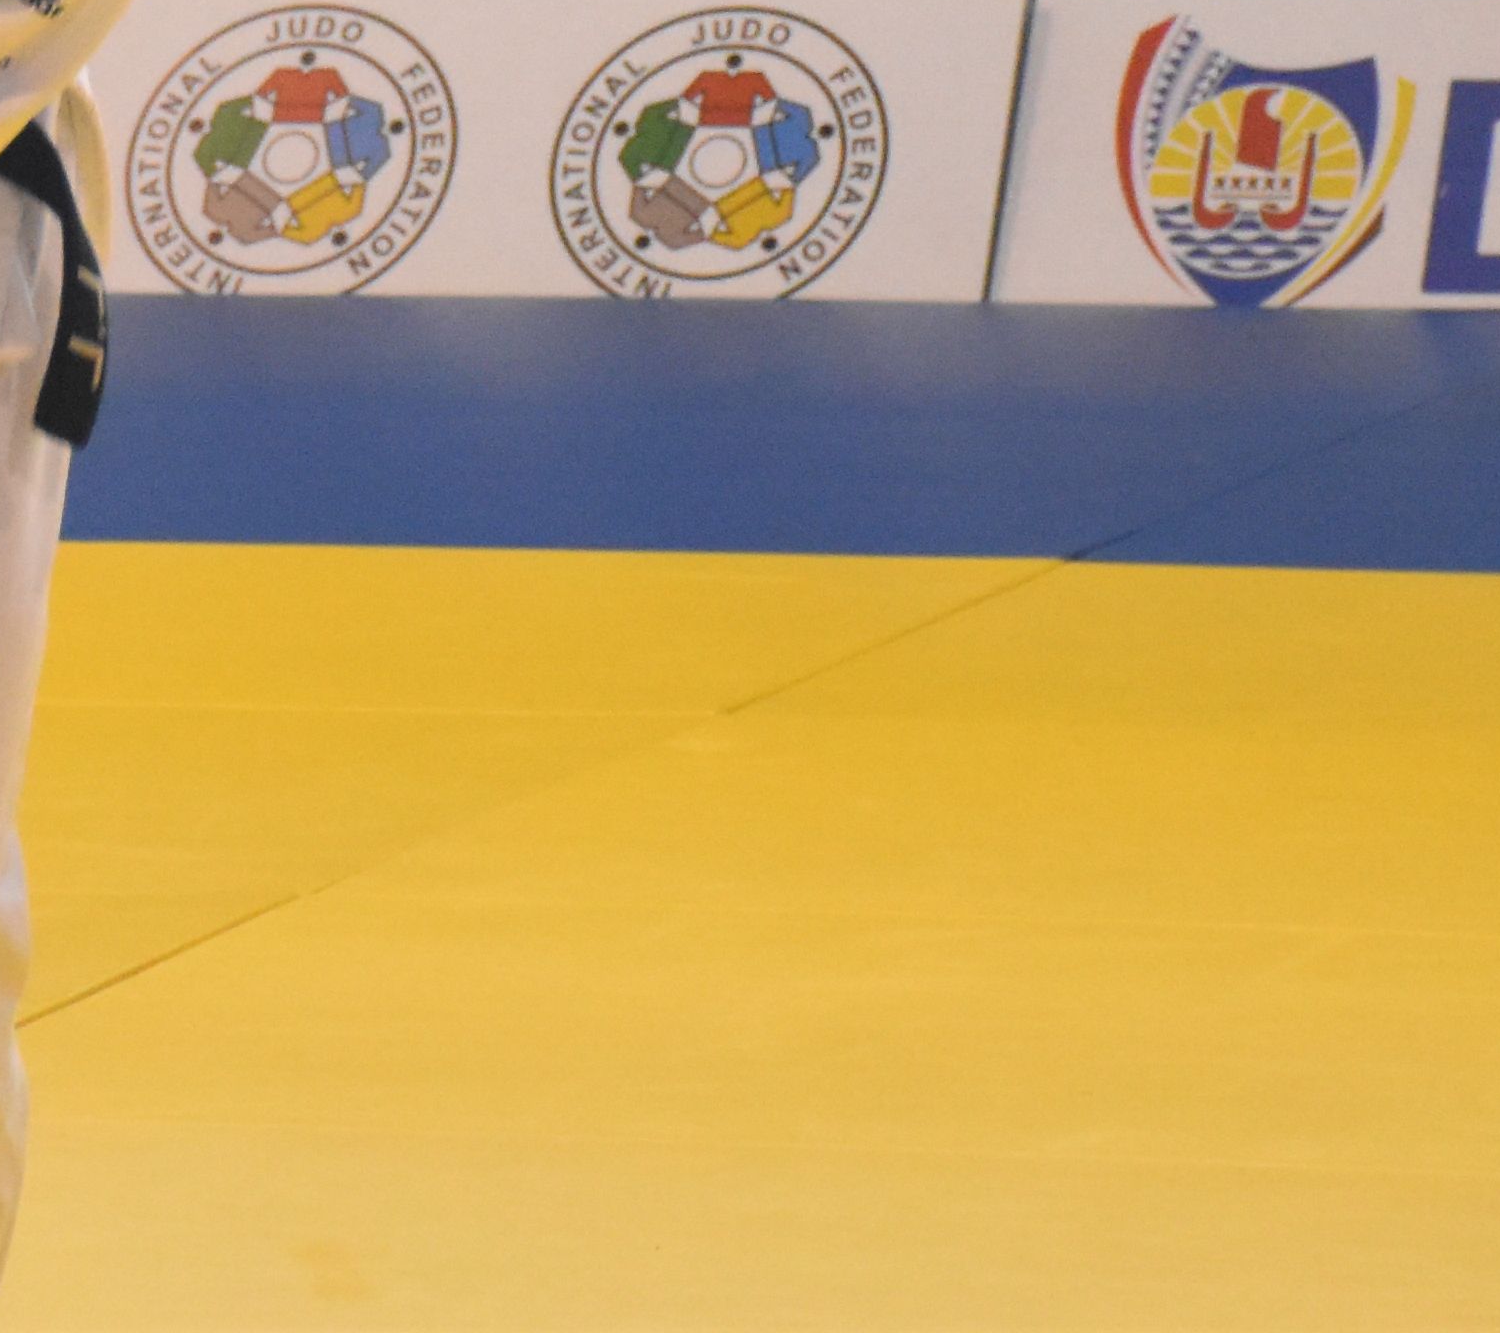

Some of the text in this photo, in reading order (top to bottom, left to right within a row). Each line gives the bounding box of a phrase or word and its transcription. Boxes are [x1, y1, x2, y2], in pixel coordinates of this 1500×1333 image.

[138, 14, 446, 294] INTERNATIONAL JUDO FEDERATION
[562, 18, 877, 299] INTERNATIONAL JUDO FEDERATION
